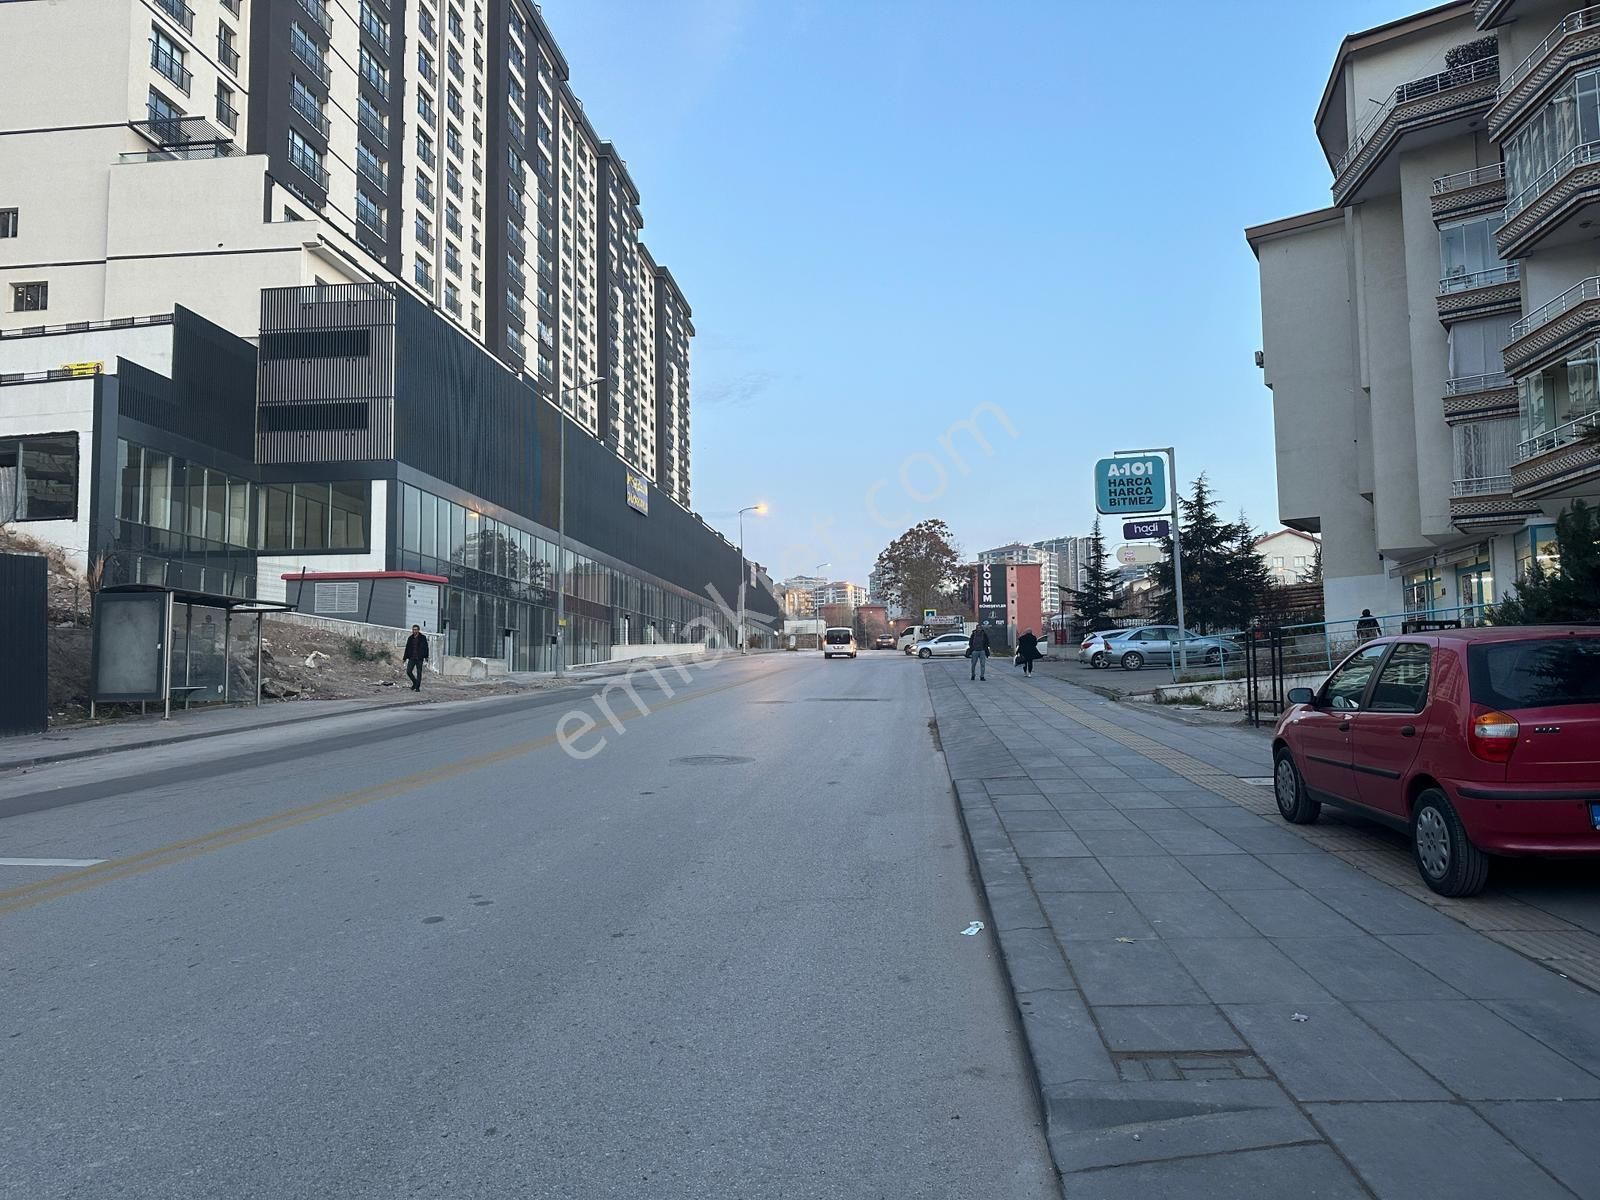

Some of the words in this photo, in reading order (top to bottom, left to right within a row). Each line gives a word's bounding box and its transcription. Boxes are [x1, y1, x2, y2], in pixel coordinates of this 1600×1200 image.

[1108, 477, 1152, 487] HARCA
[1109, 487, 1152, 497] HARCA
[1134, 523, 1158, 533] hadi
[983, 564, 992, 602] KONUM
